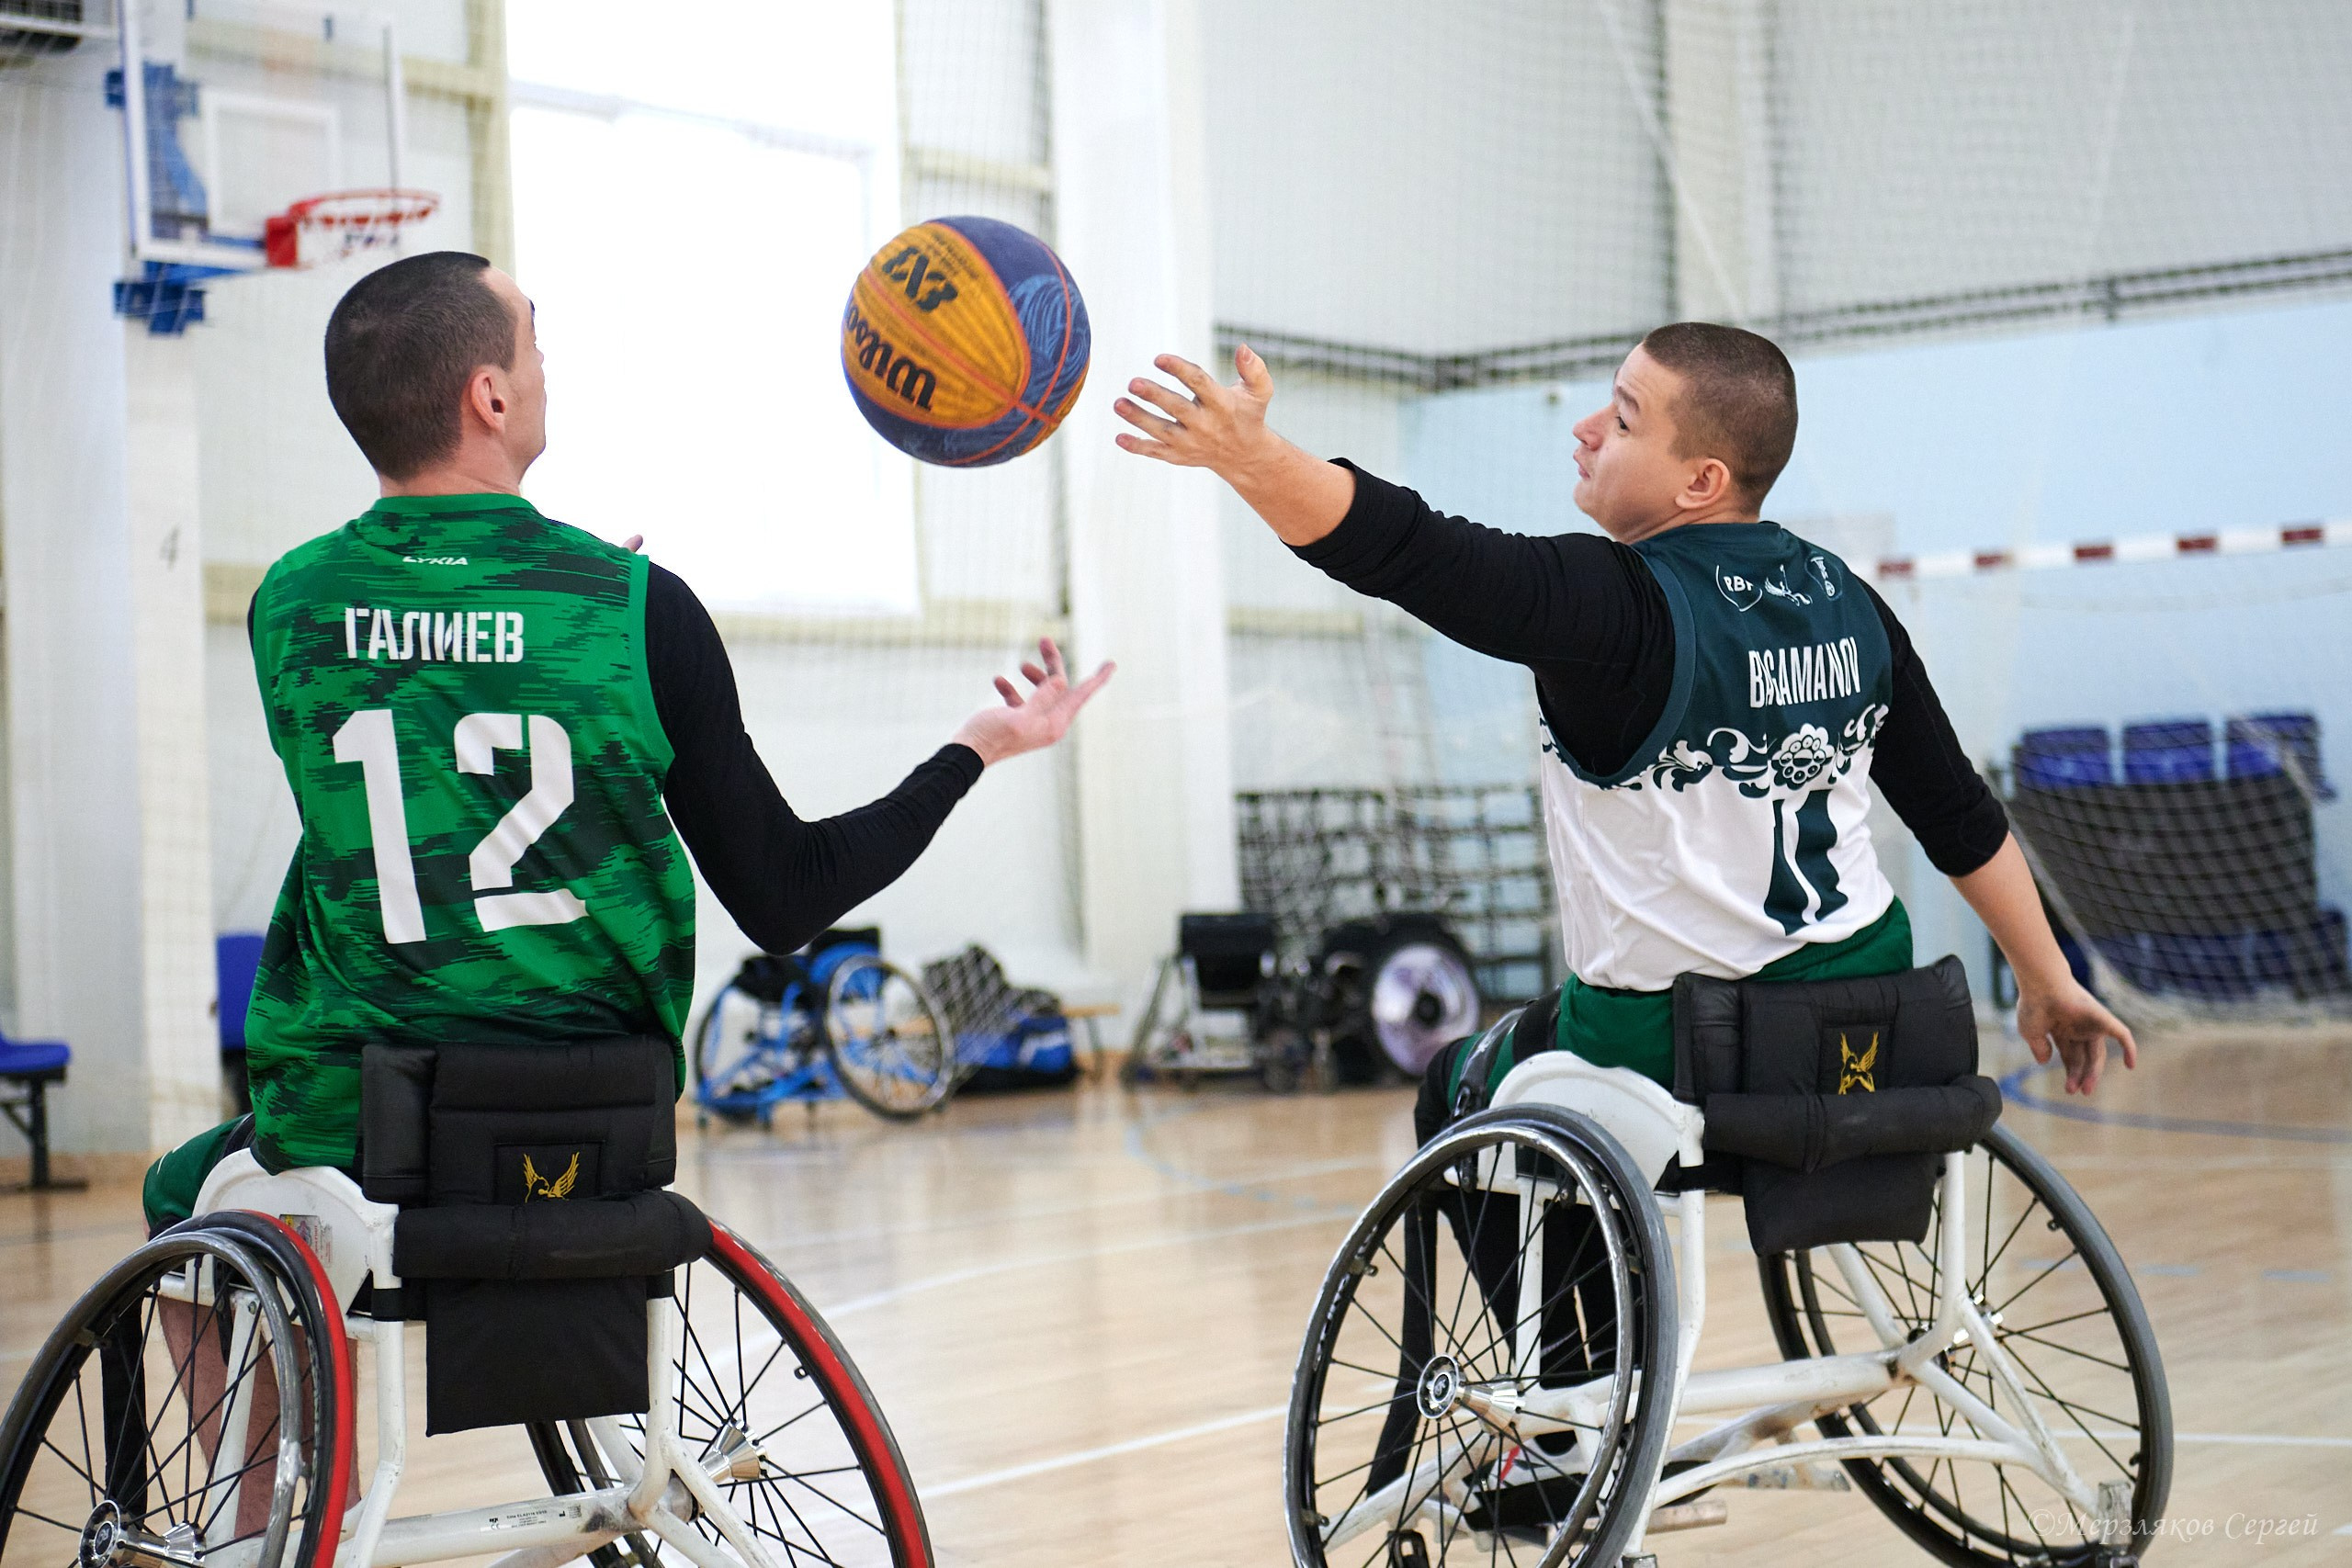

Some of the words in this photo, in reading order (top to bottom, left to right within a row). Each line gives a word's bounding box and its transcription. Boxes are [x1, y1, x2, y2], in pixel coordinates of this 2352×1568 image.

[846, 304, 937, 412] Wilso
[345, 607, 525, 663] ГАЛИЕВ
[332, 709, 590, 944] 12
